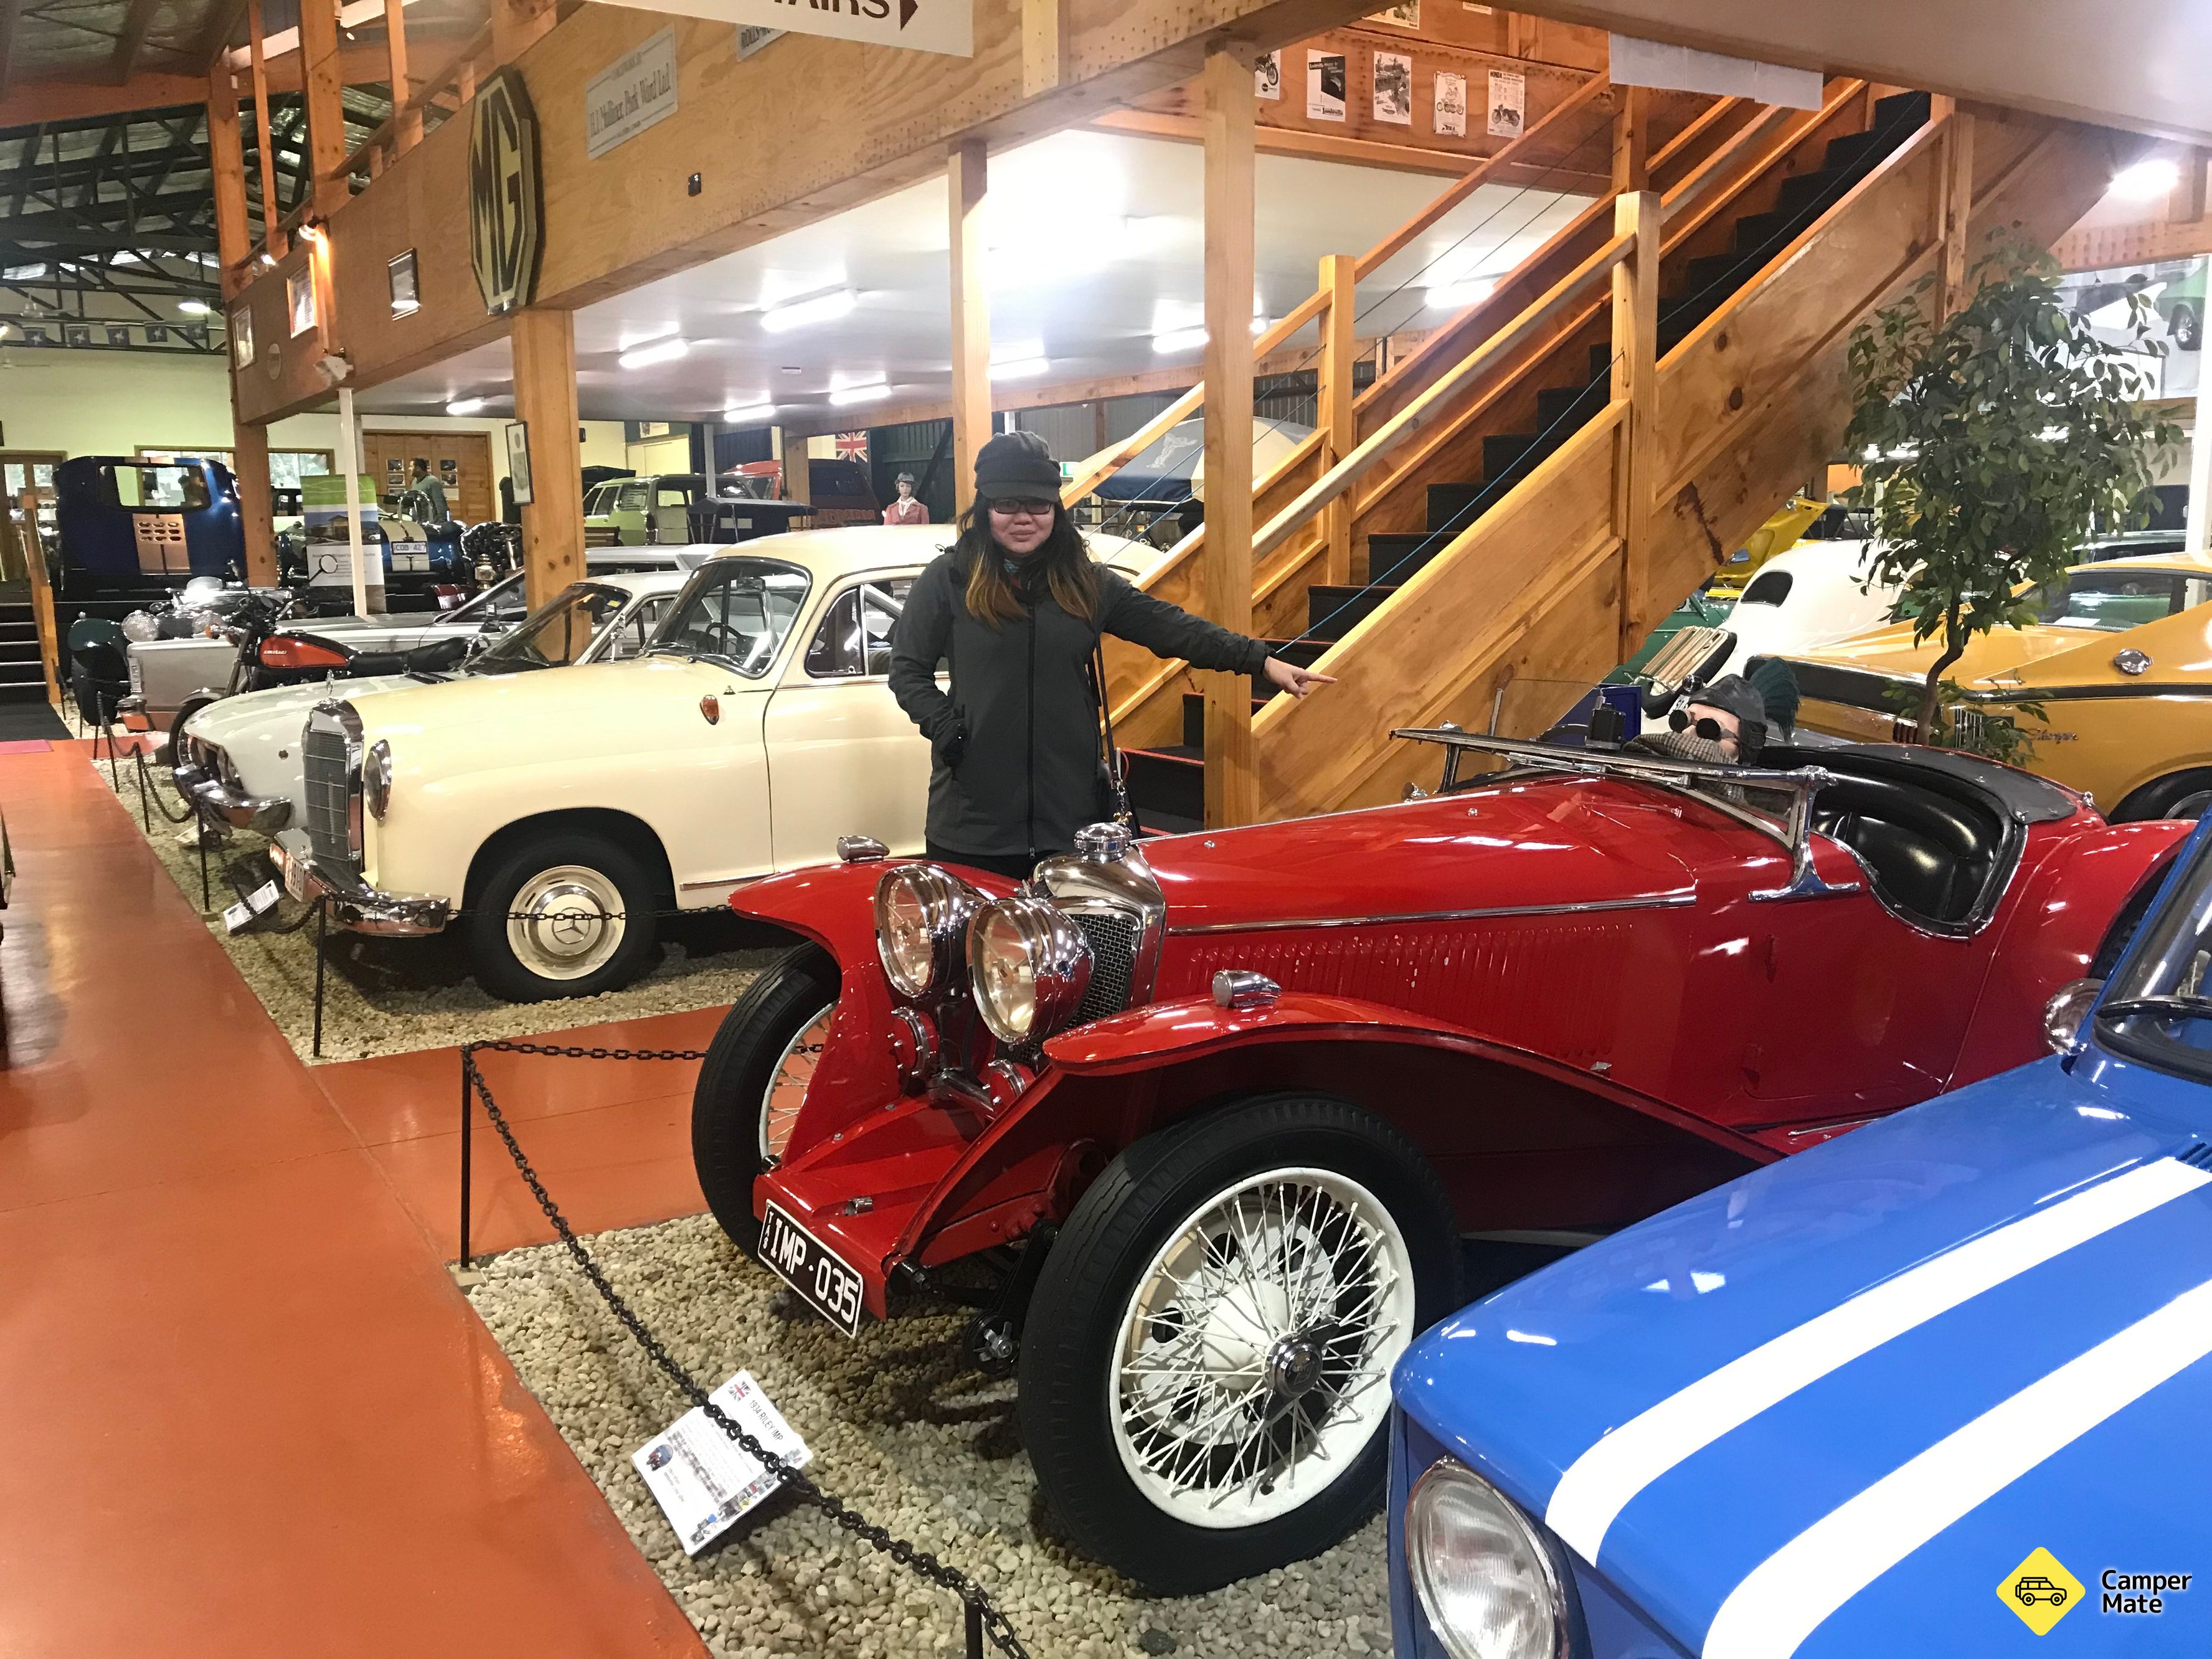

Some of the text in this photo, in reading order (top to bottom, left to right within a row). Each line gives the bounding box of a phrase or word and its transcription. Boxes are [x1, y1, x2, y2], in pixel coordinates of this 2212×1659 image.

[472, 87, 522, 296] MG
[749, 1400, 783, 1440] 1934 RILEY IMP
